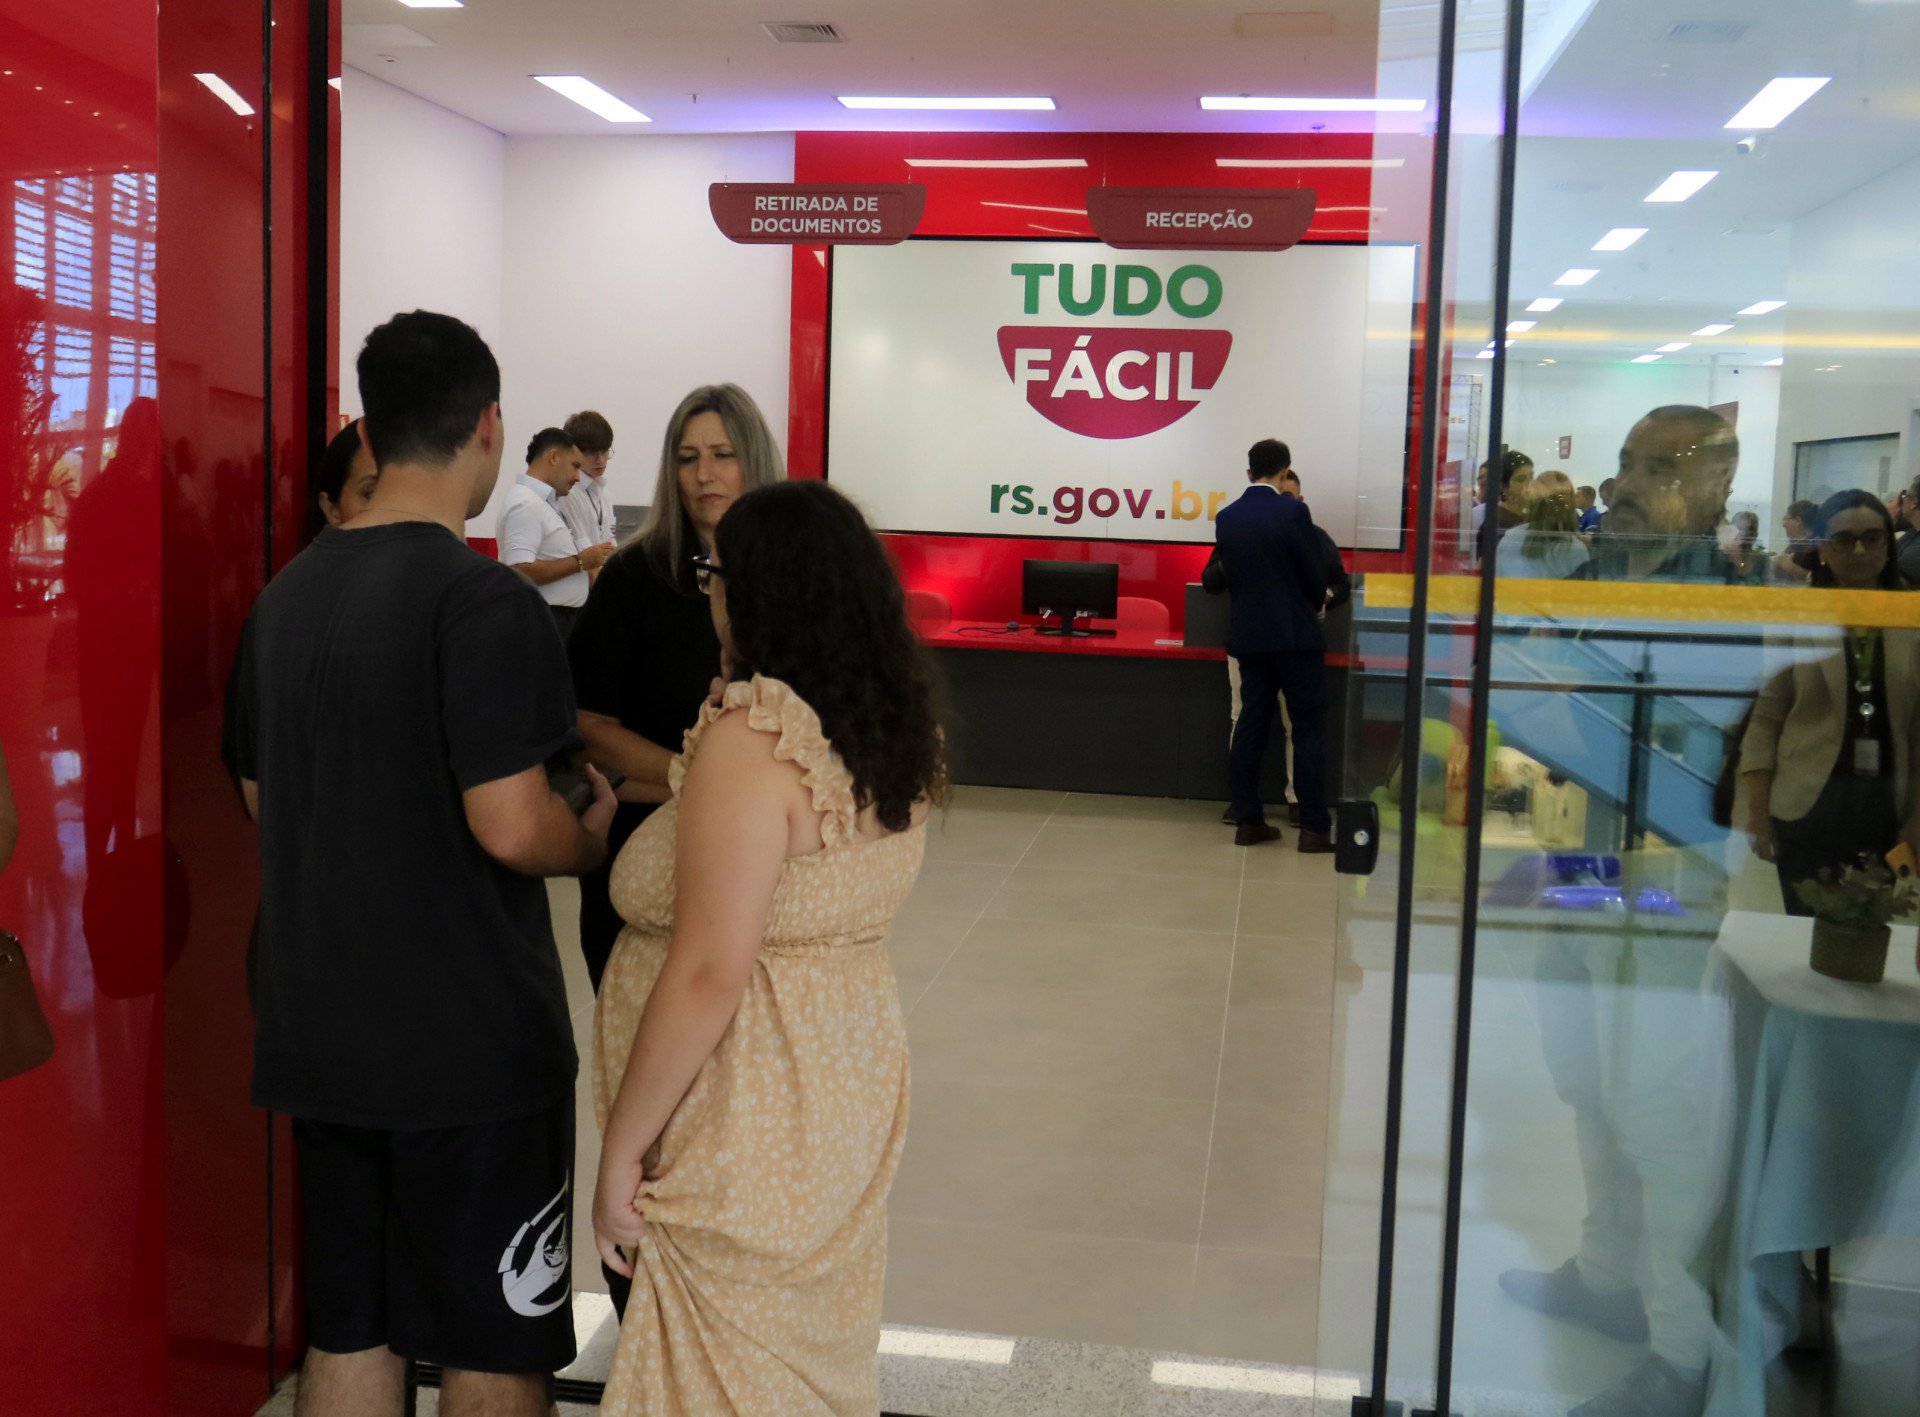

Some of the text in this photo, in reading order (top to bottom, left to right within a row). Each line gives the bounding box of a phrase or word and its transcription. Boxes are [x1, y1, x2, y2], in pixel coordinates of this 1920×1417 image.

[754, 196, 878, 212] RETIRADA DE
[1145, 208, 1253, 231] RECEPÇÃO
[750, 217, 882, 234] DOCUMENTOS
[1010, 263, 1223, 319] TUDO
[1013, 334, 1213, 402] FÁCIL
[990, 479, 1227, 525] rs.gov.br
